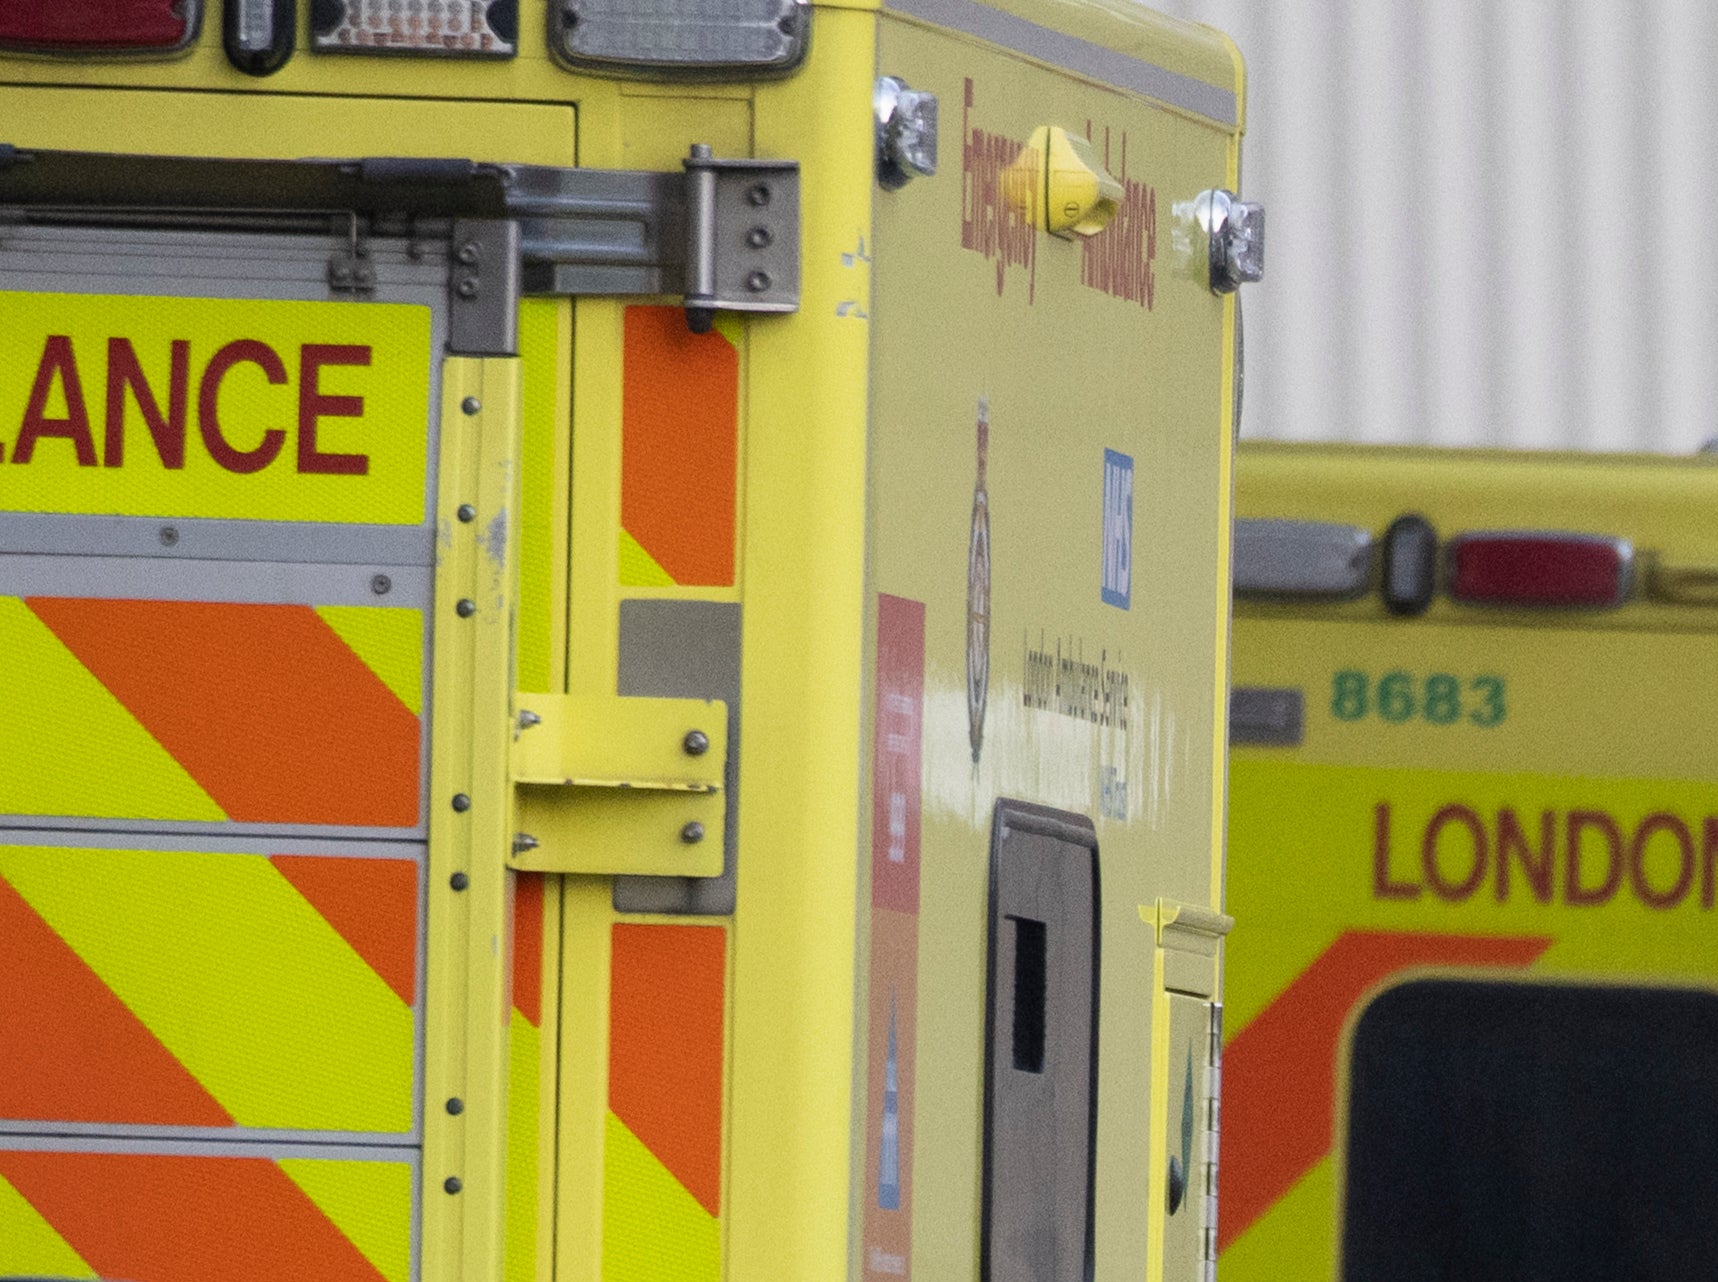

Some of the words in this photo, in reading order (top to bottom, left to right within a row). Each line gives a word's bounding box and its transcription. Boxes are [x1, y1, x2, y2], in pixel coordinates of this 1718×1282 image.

[0, 335, 372, 476] ANCE
[1102, 460, 1132, 597] NHS
[1331, 670, 1507, 728] 8683
